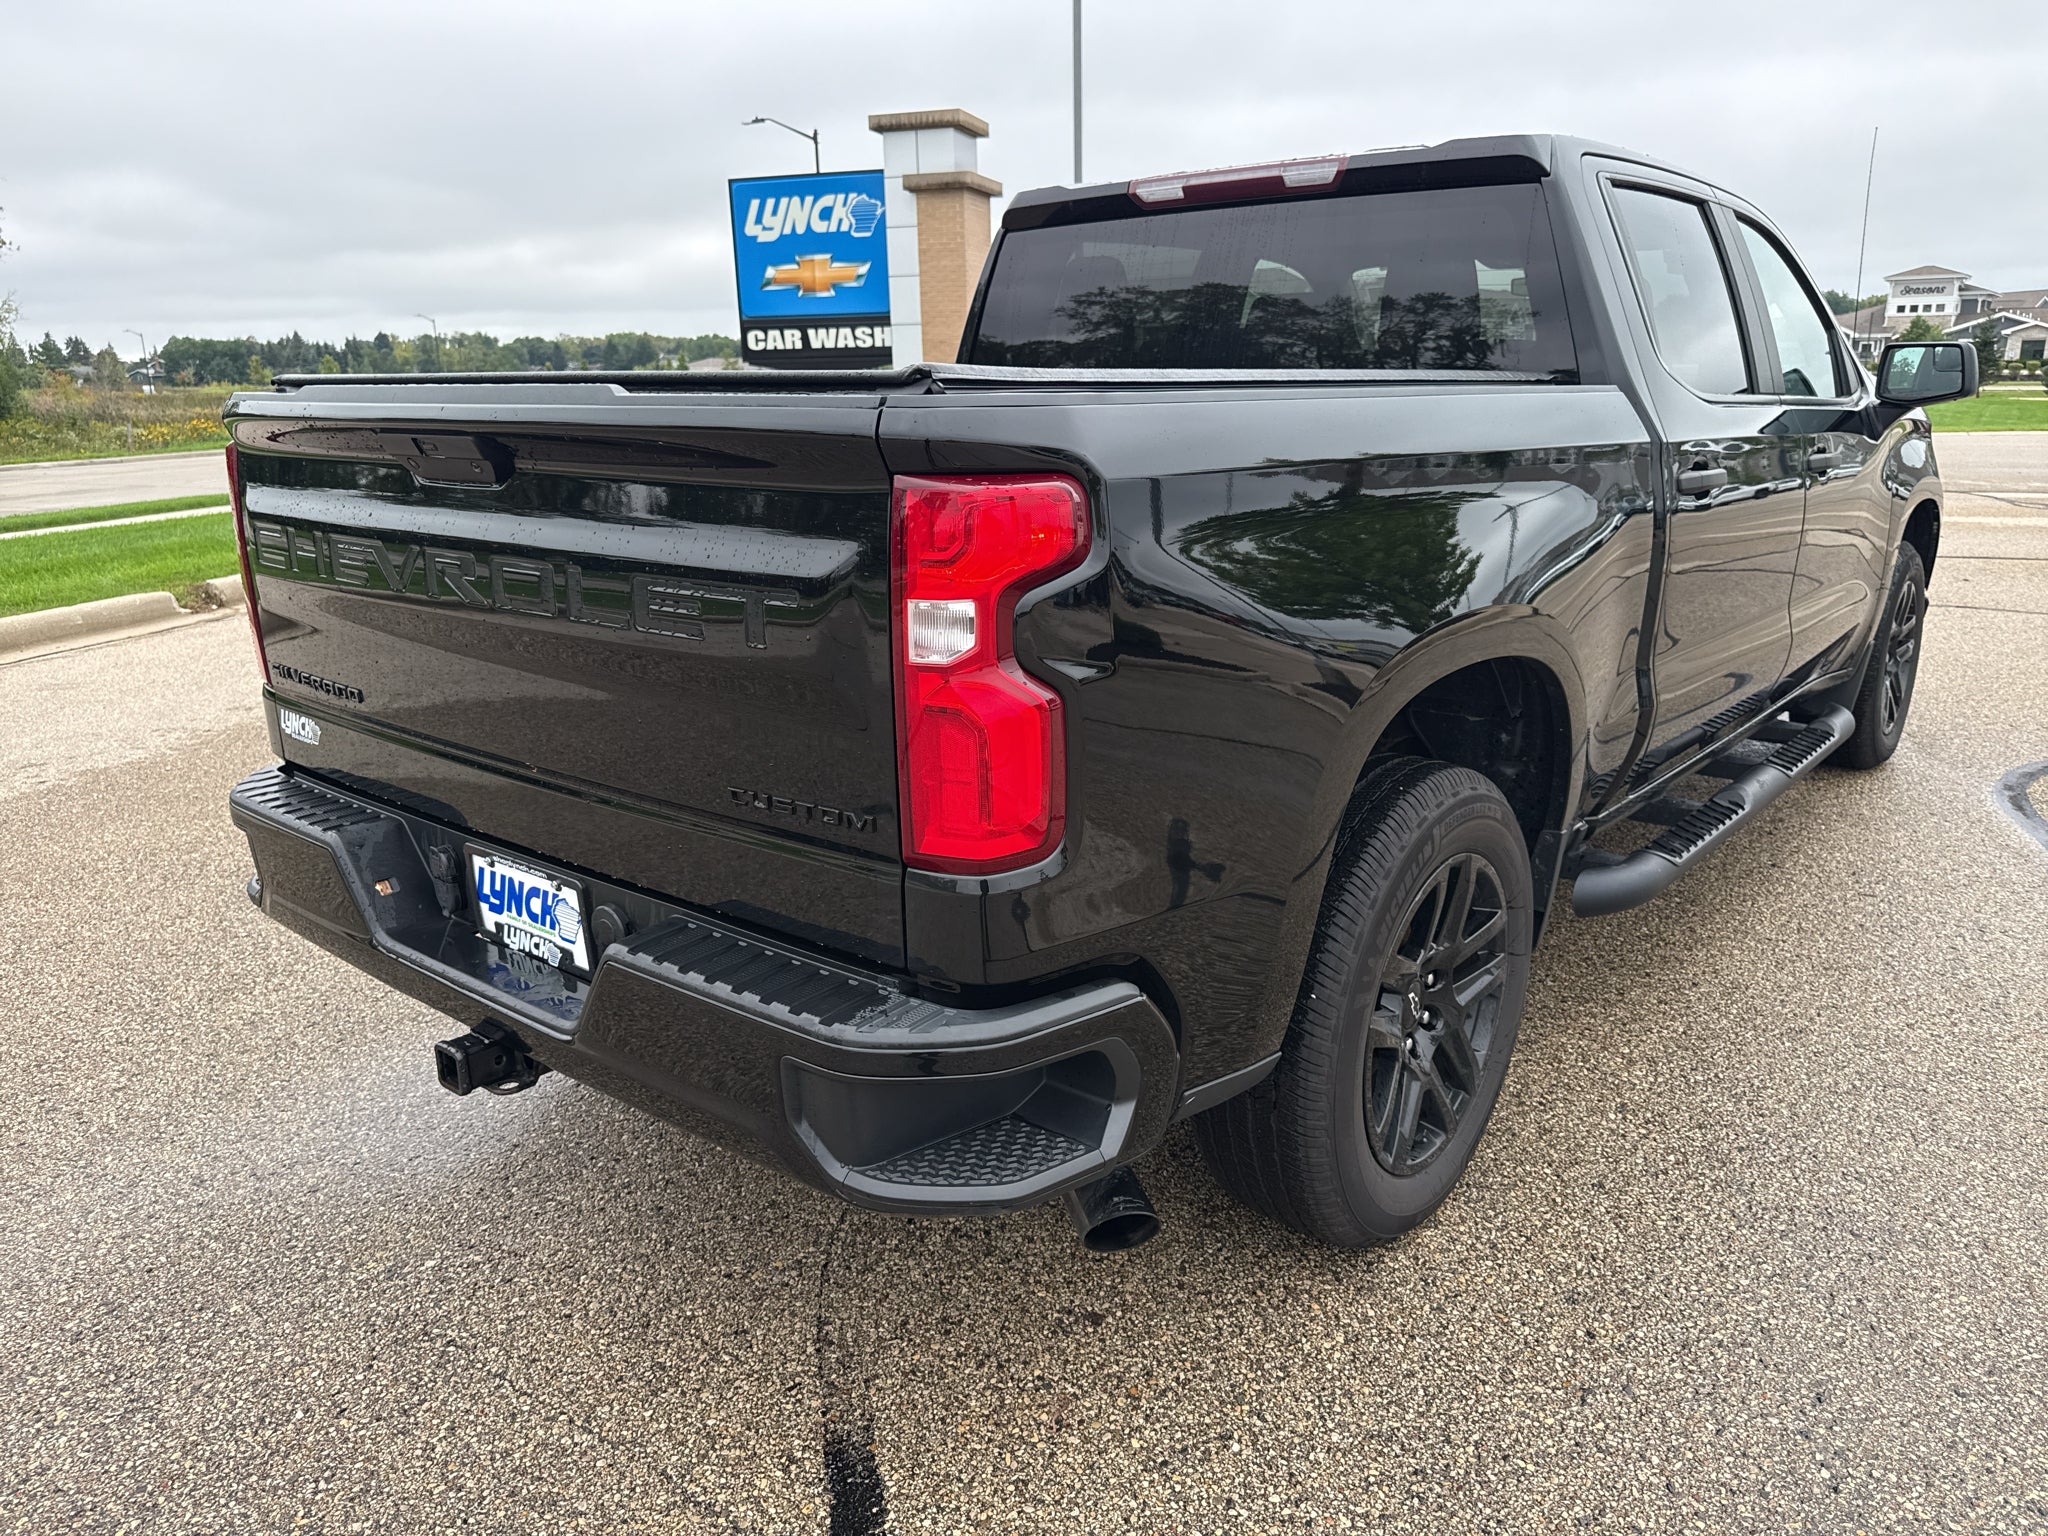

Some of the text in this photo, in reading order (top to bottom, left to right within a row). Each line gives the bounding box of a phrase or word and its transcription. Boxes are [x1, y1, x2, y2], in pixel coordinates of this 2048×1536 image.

[744, 193, 857, 242] LYNCH
[1900, 285, 1947, 296] Seasons
[746, 326, 892, 350] CAR WASH
[254, 521, 799, 649] CHEVROLET
[272, 662, 365, 703] SILVERADO
[280, 708, 313, 739] LYNCH
[727, 786, 878, 833] CUSTOM
[477, 866, 560, 931] LYNCH
[1376, 840, 1433, 953] MICHELIN
[503, 923, 550, 960] LYNCH
